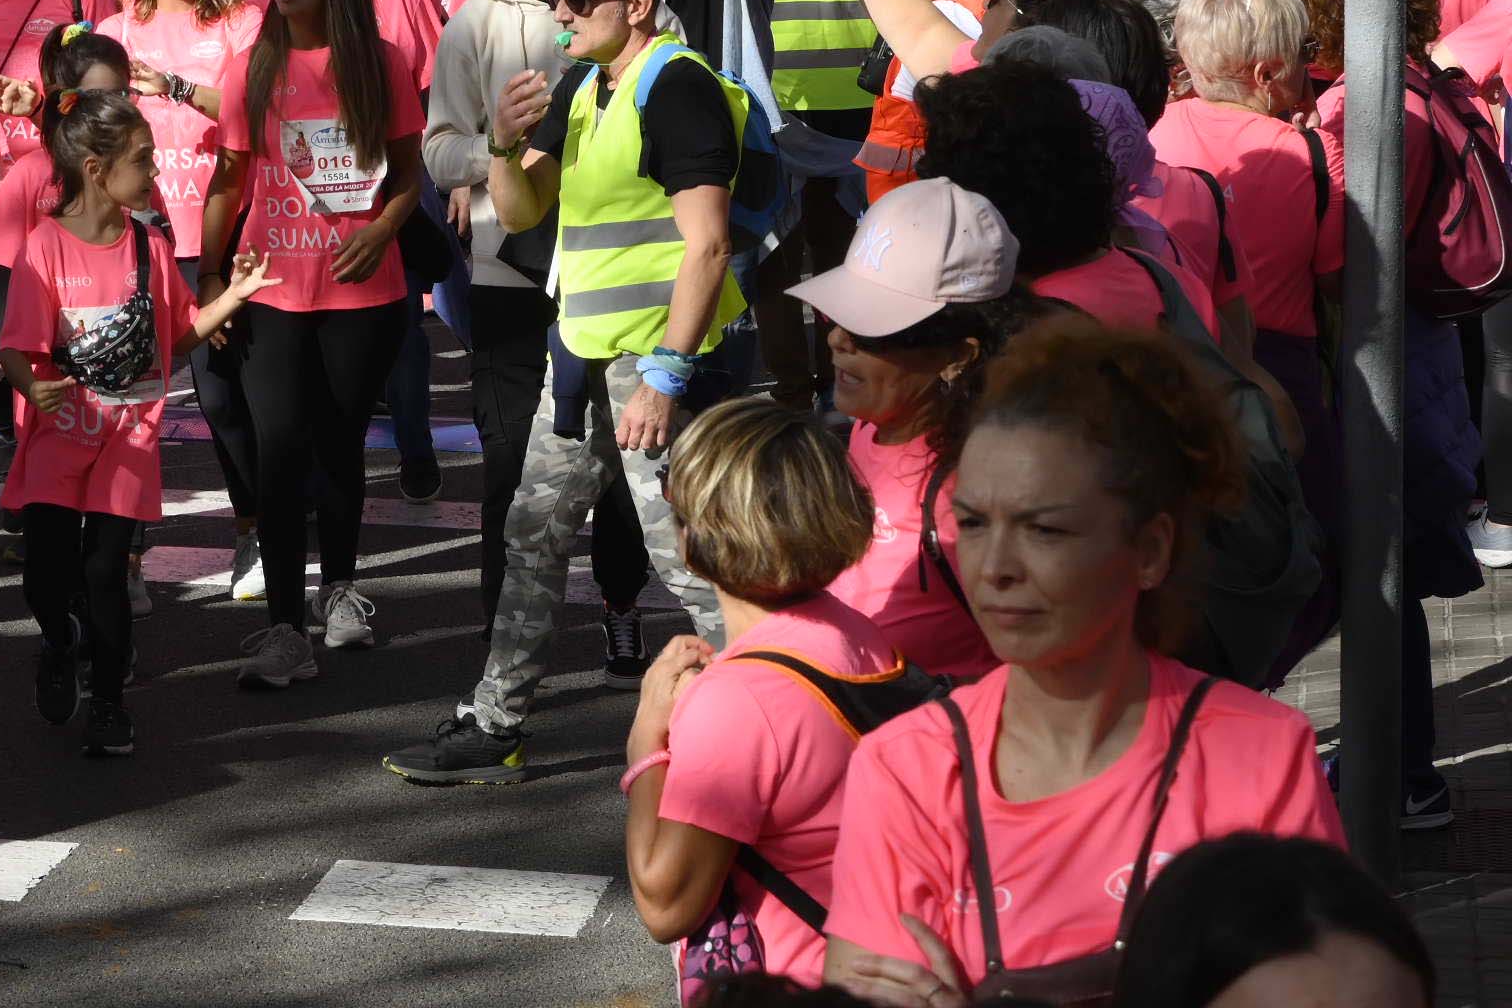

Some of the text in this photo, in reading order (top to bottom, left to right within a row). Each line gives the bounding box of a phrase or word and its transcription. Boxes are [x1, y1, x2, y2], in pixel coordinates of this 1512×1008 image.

[317, 155, 353, 170] 016
[322, 172, 350, 183] 15584
[159, 178, 201, 201] MA
[267, 227, 342, 250] SUMA
